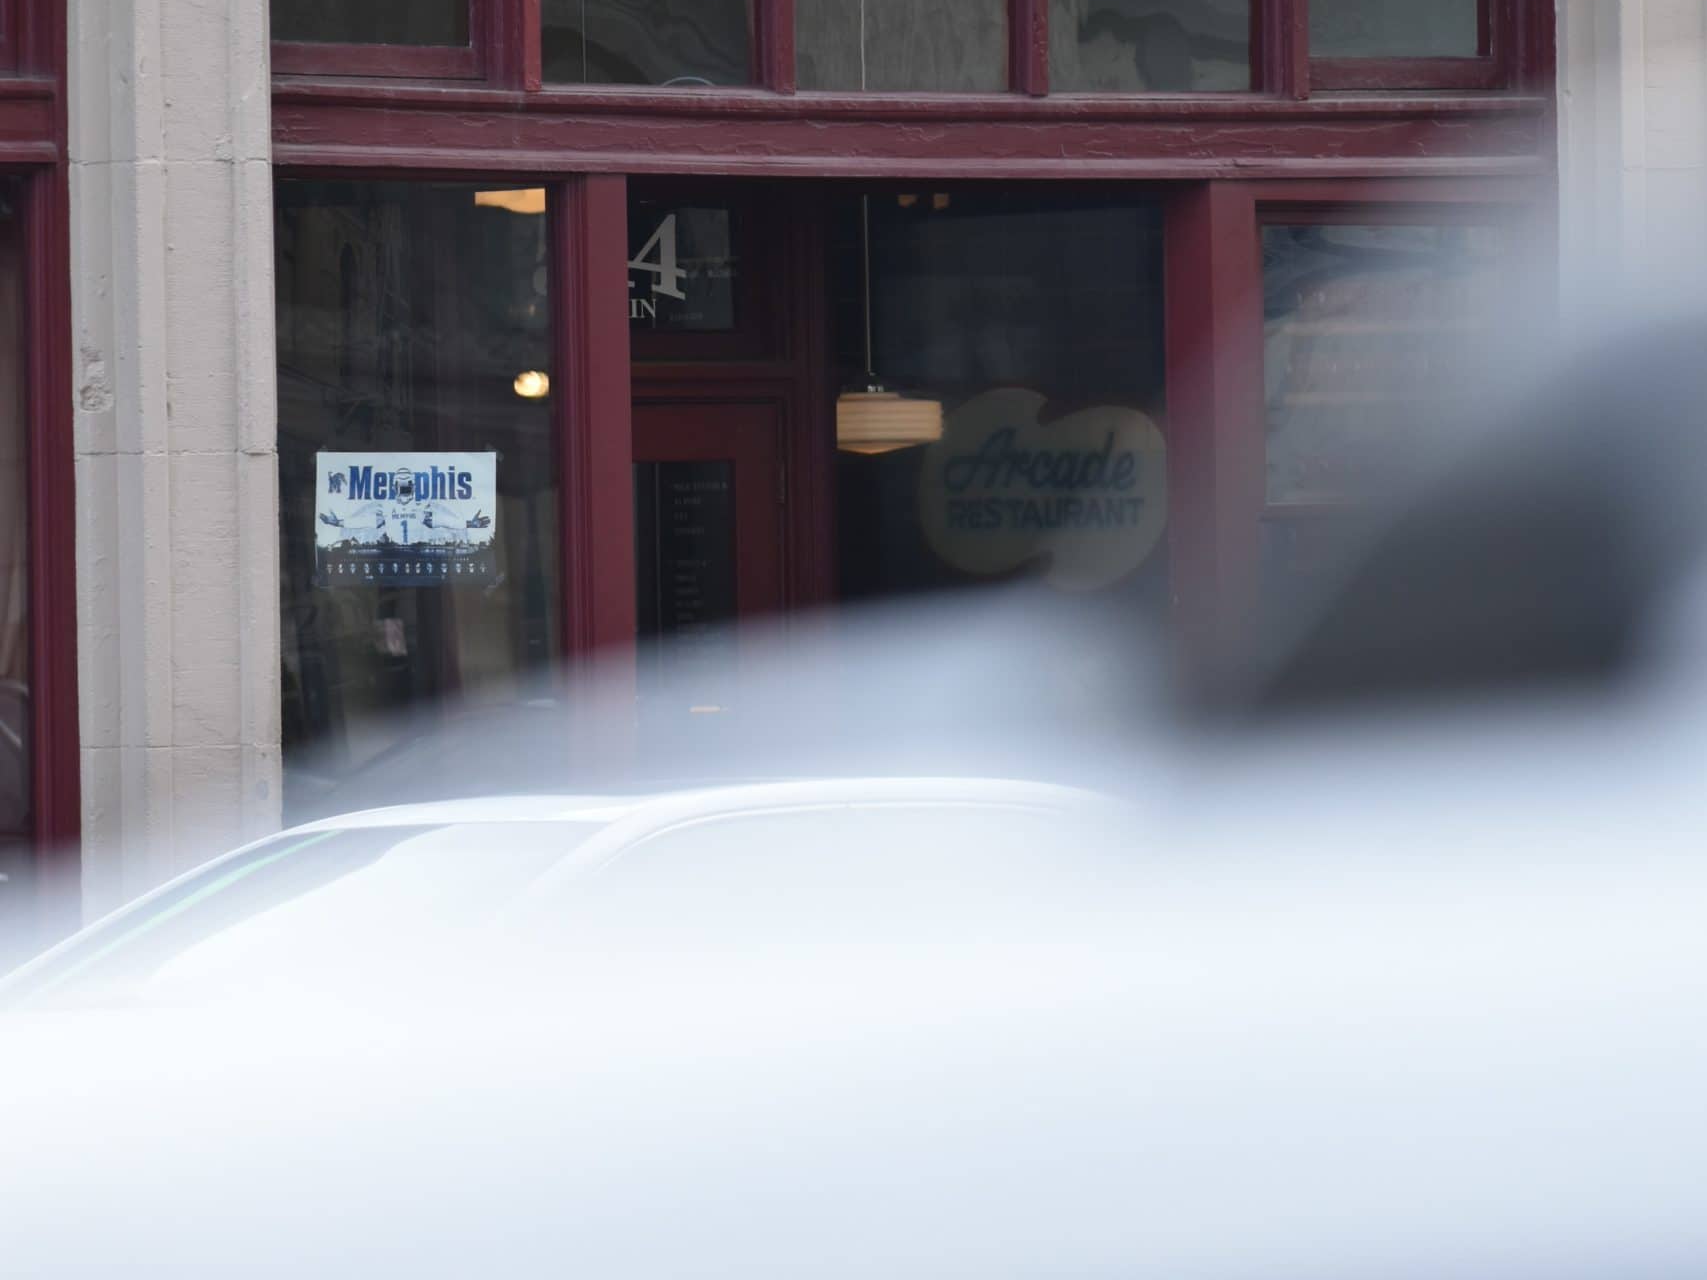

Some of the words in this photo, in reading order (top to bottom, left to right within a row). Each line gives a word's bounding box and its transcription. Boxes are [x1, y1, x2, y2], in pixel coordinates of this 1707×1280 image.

[628, 298, 656, 318] IN
[944, 427, 1136, 491] Arcade
[348, 465, 472, 500] Mephis
